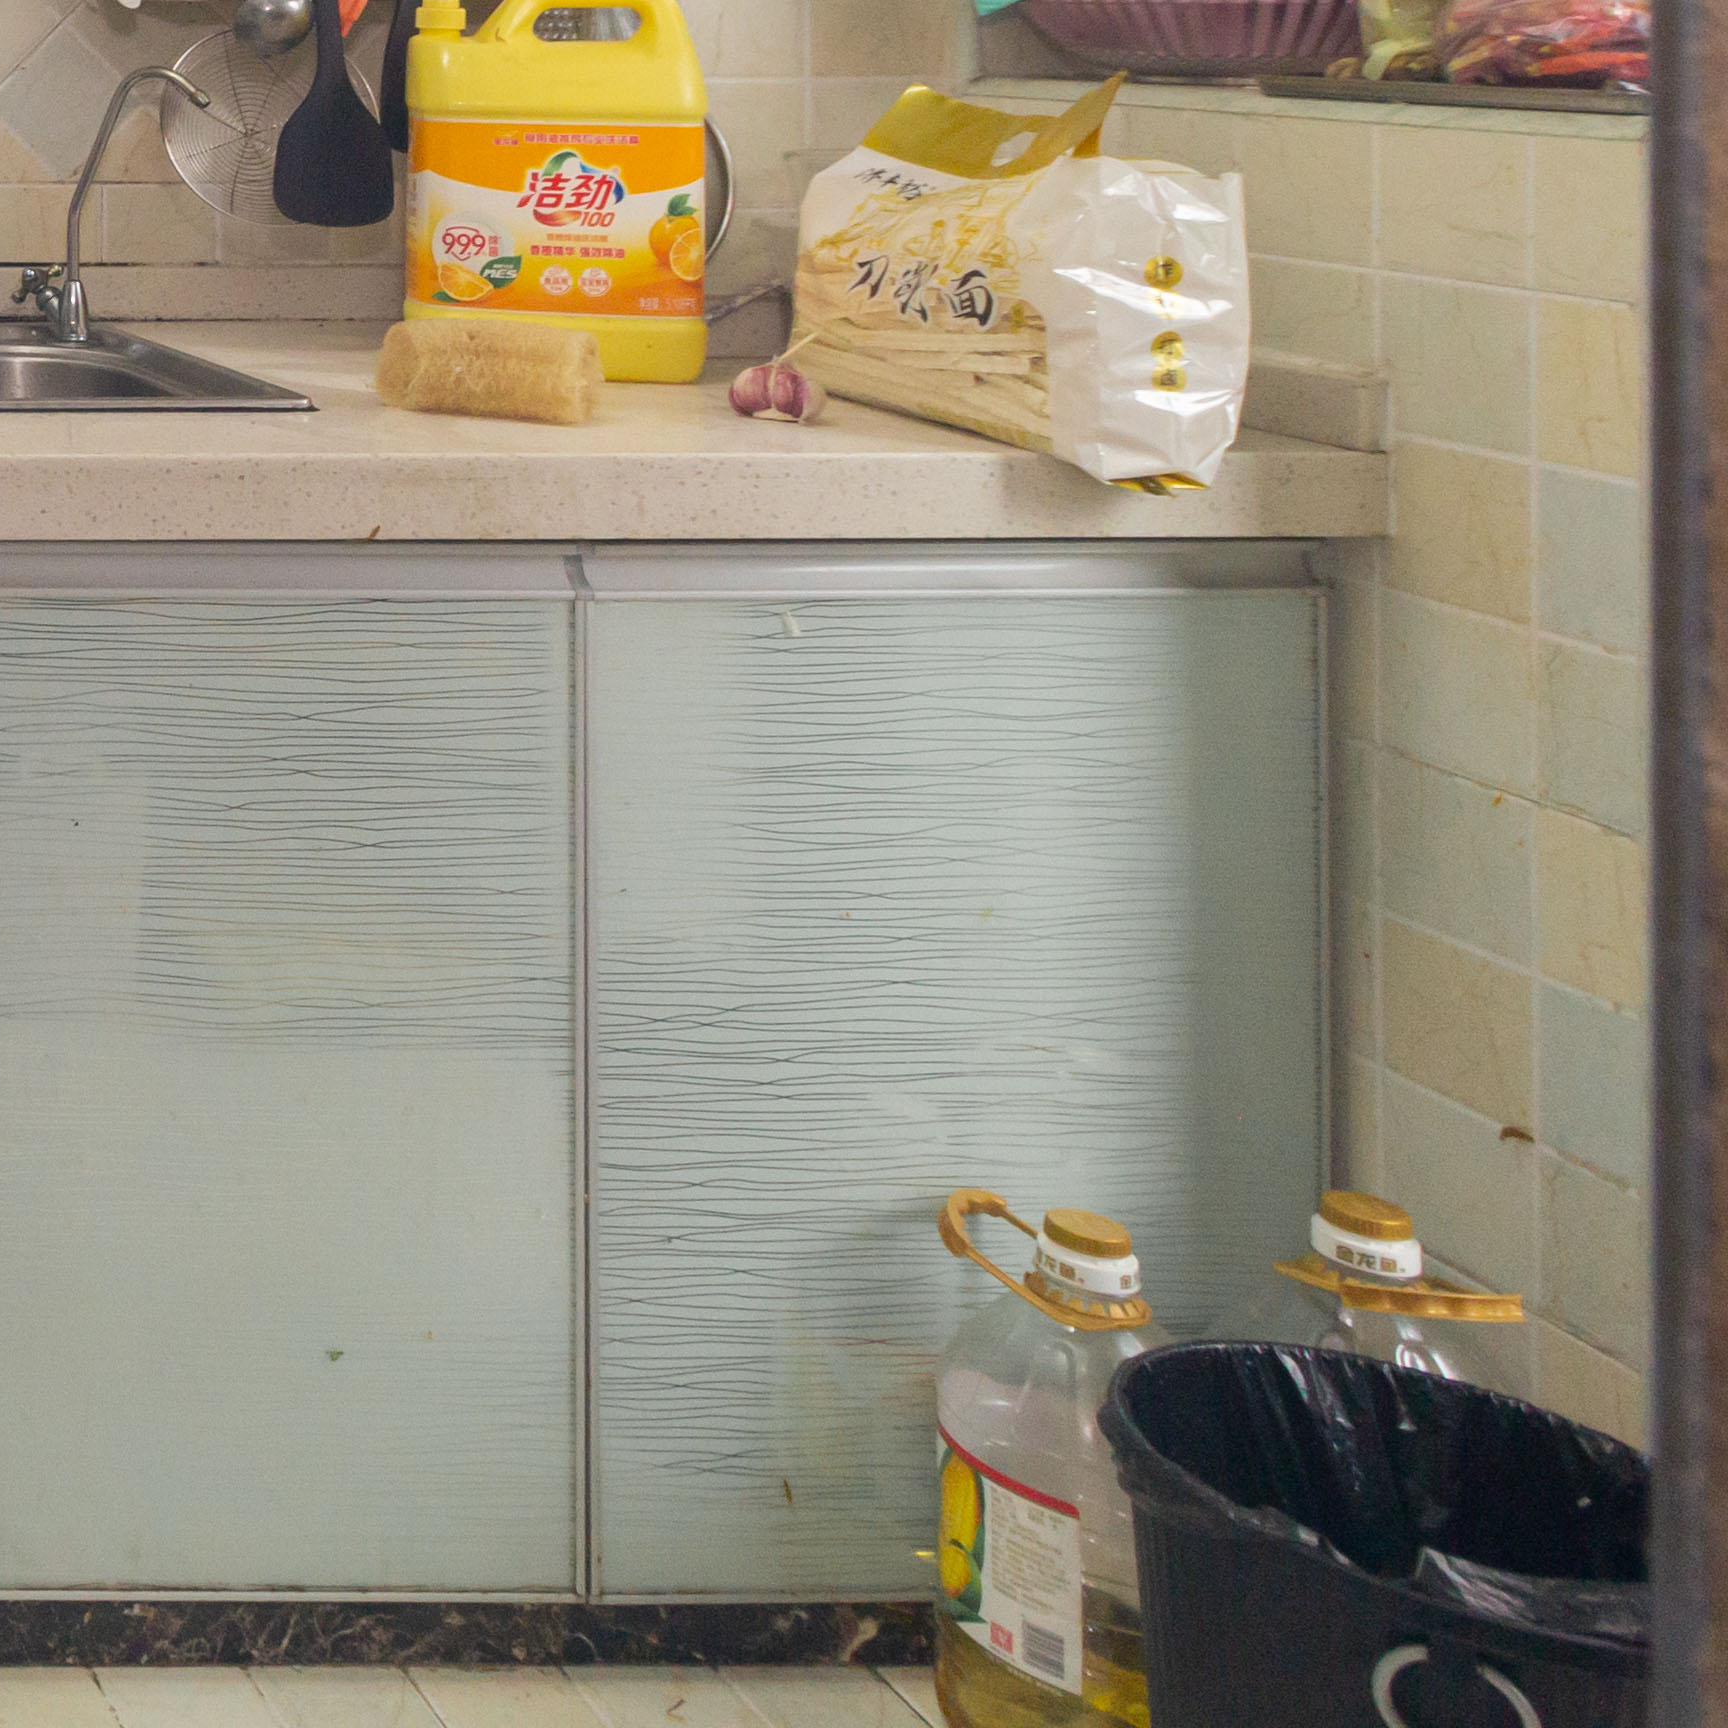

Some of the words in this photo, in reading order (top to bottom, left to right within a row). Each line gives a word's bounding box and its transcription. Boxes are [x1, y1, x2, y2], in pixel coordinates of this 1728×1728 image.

[516, 172, 614, 211] 洁劲
[580, 212, 615, 227] 100
[442, 233, 486, 256] 999
